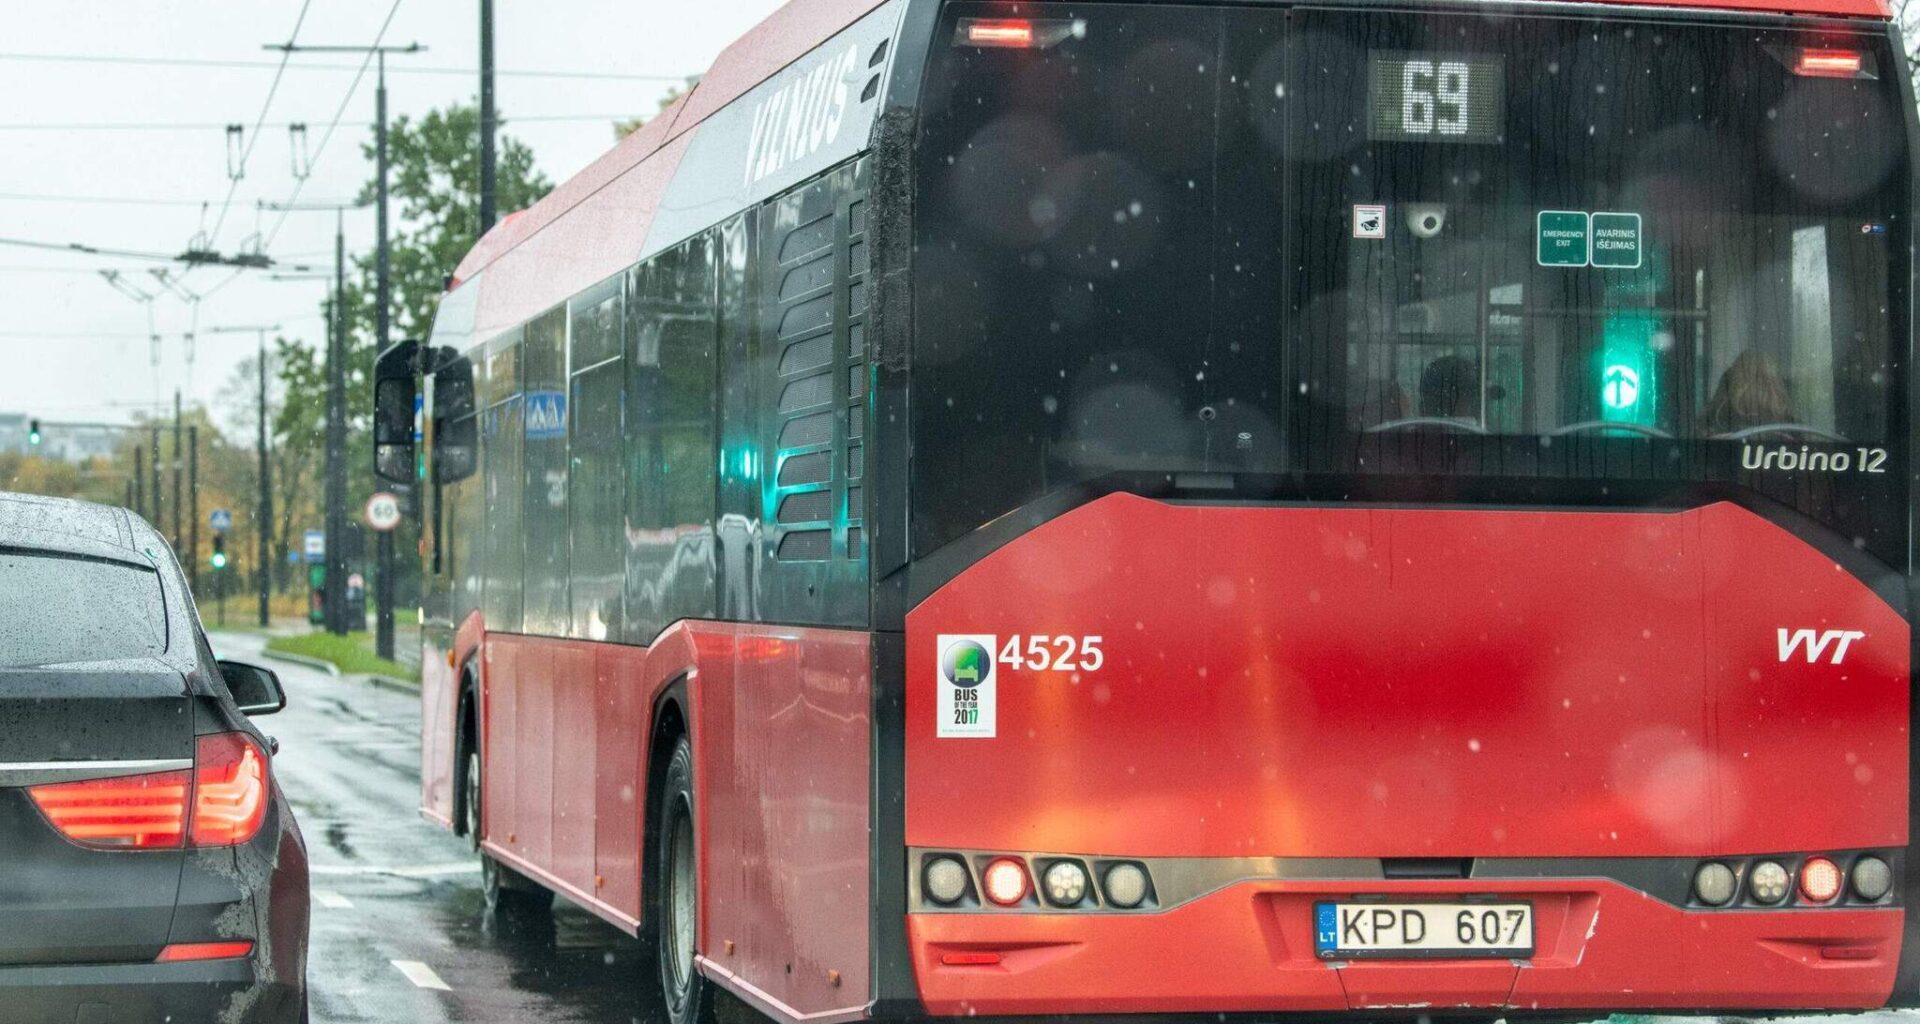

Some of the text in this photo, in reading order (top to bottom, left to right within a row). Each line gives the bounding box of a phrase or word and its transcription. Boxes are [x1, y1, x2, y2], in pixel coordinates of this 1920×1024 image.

[1403, 61, 1468, 134] 69
[744, 43, 857, 189] VILNIUS
[1543, 230, 1584, 238] EMERGENCY
[1596, 229, 1635, 238] AVARINIS
[1742, 445, 1887, 473] Urbino 12
[373, 503, 394, 519] 60
[998, 634, 1104, 671] 4525
[954, 688, 978, 701] BUS
[954, 708, 979, 724] 2017
[1342, 909, 1525, 945] KPD 607
[1319, 932, 1336, 943] LT
